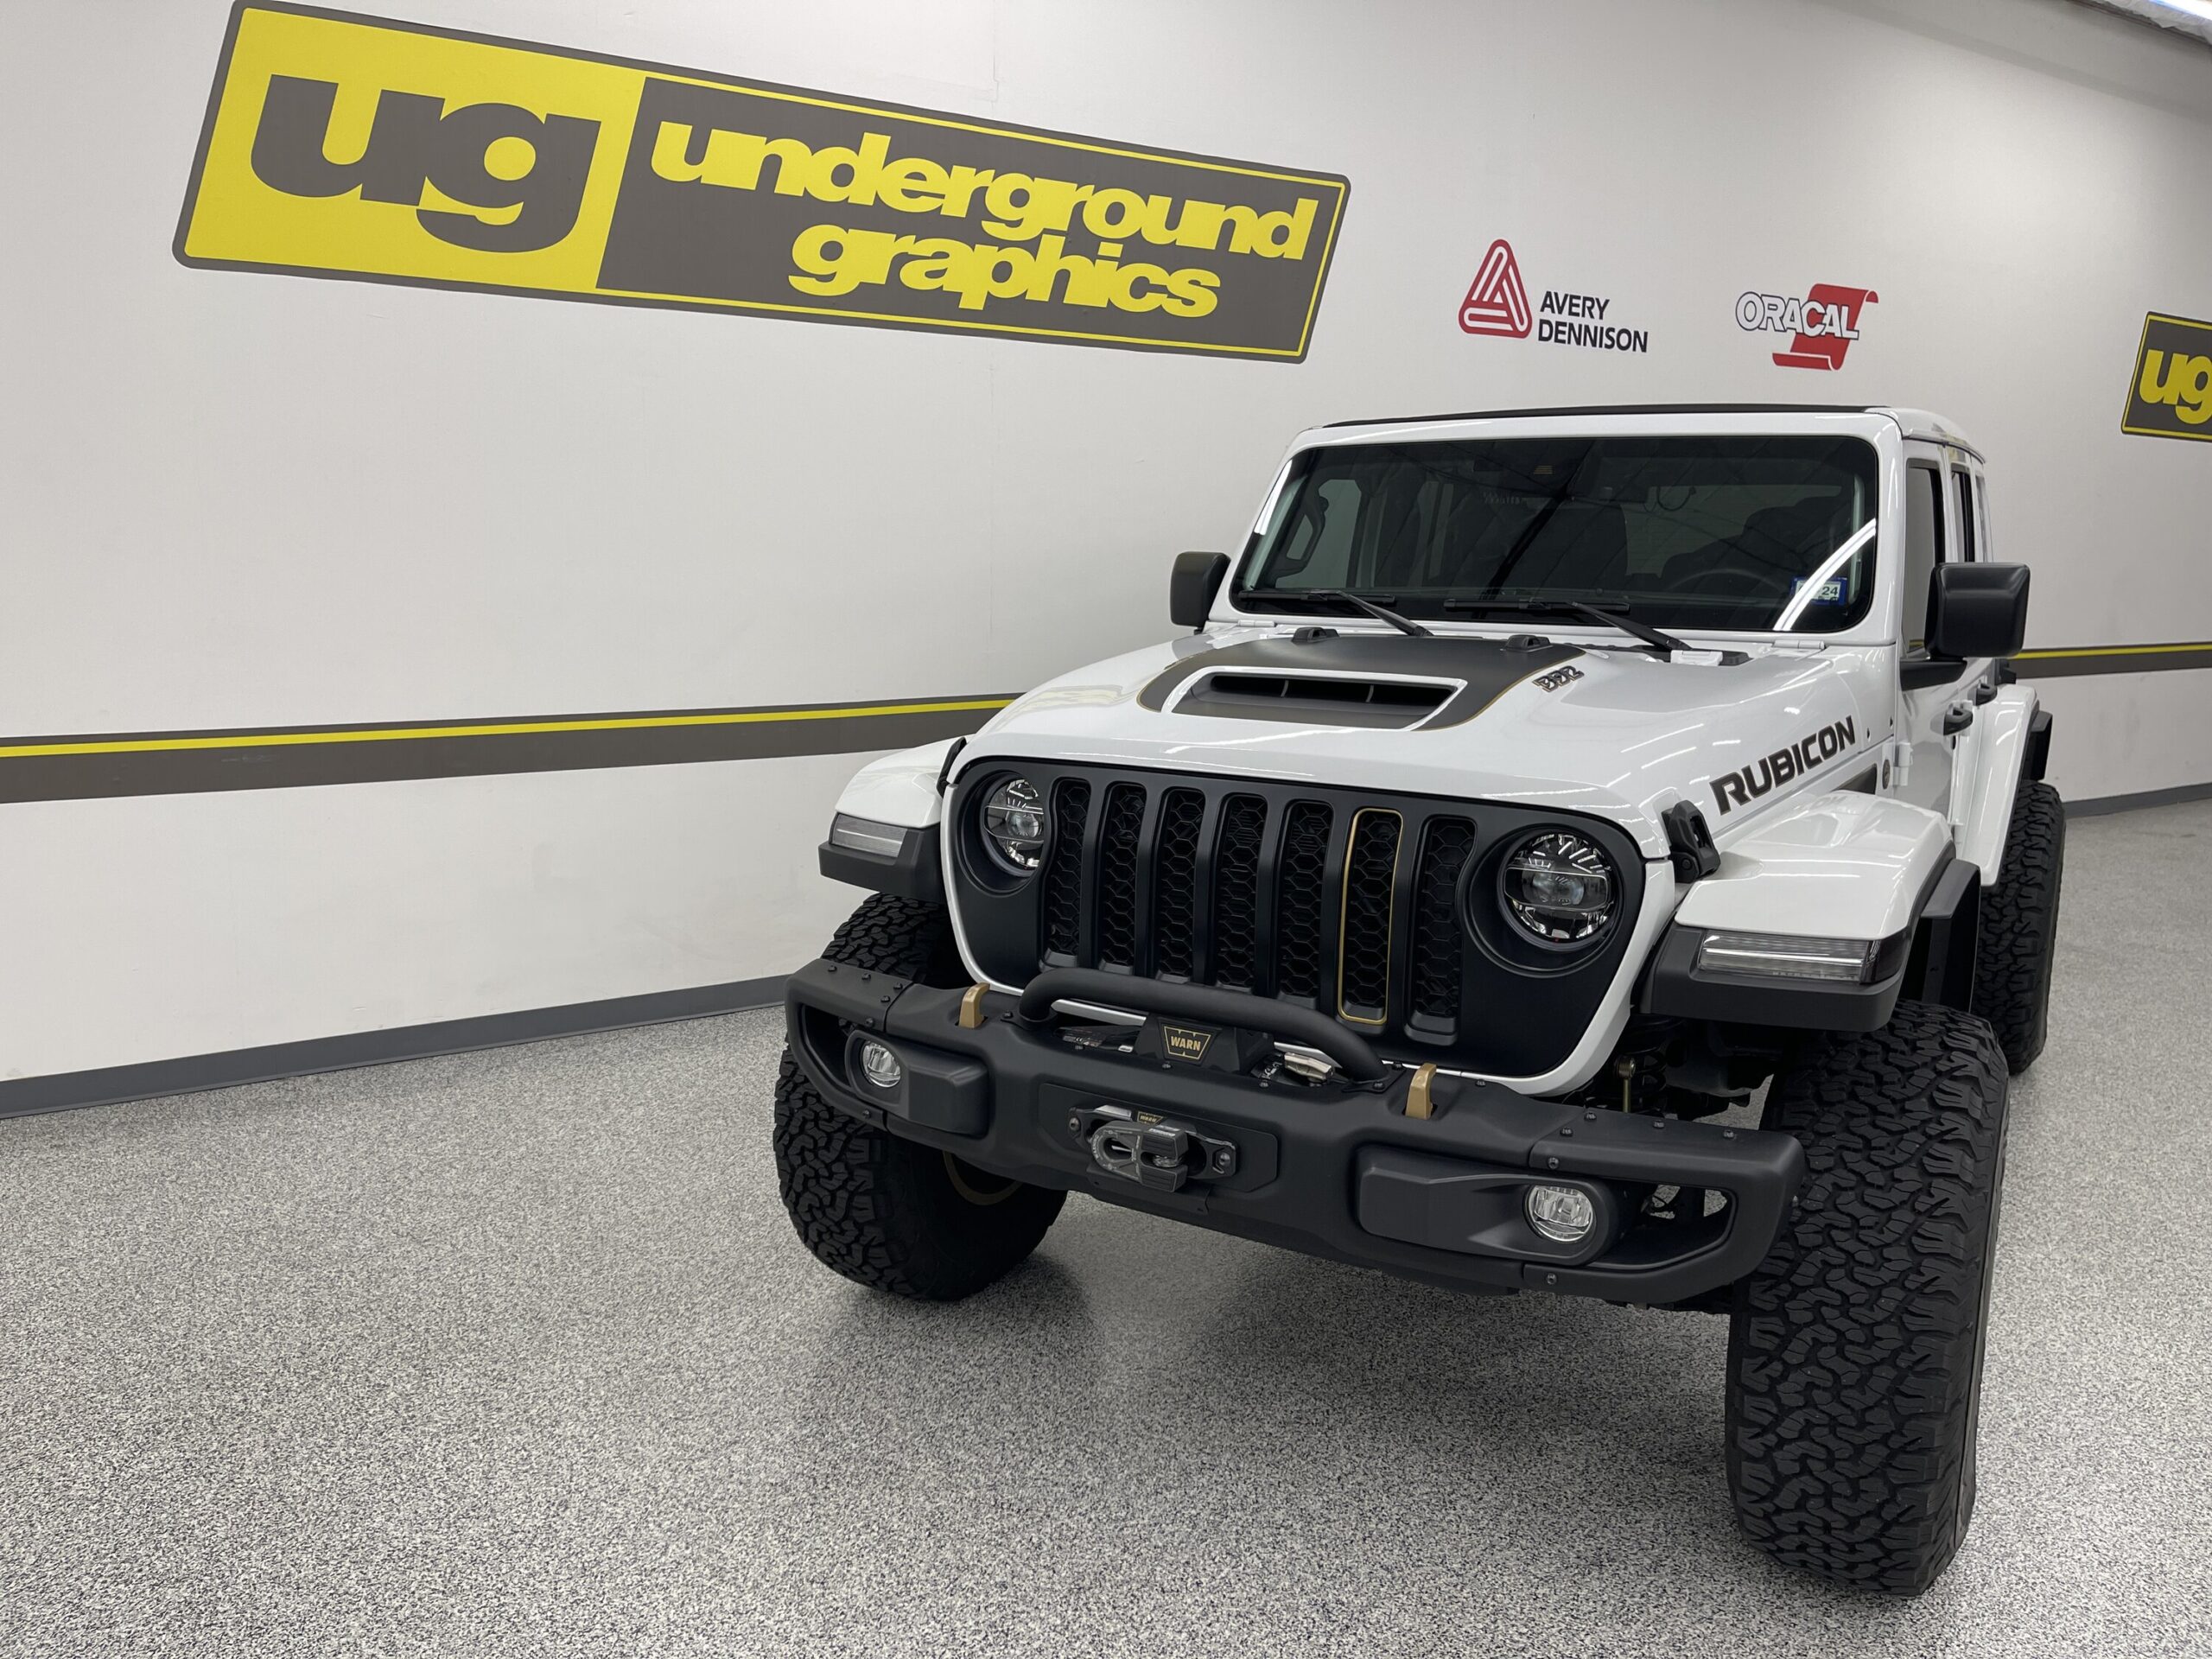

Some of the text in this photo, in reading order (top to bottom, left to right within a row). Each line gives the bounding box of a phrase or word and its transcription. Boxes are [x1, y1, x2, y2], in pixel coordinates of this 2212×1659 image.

[251, 73, 601, 253] ug
[651, 121, 1319, 261] underground
[788, 224, 1217, 317] graphics
[1540, 290, 1610, 321] AVERY
[1538, 318, 1648, 353] DENNISON
[1735, 290, 1860, 340] ORACAL
[1709, 715, 1856, 816] RUBICON
[1170, 1035, 1201, 1052] WARN
